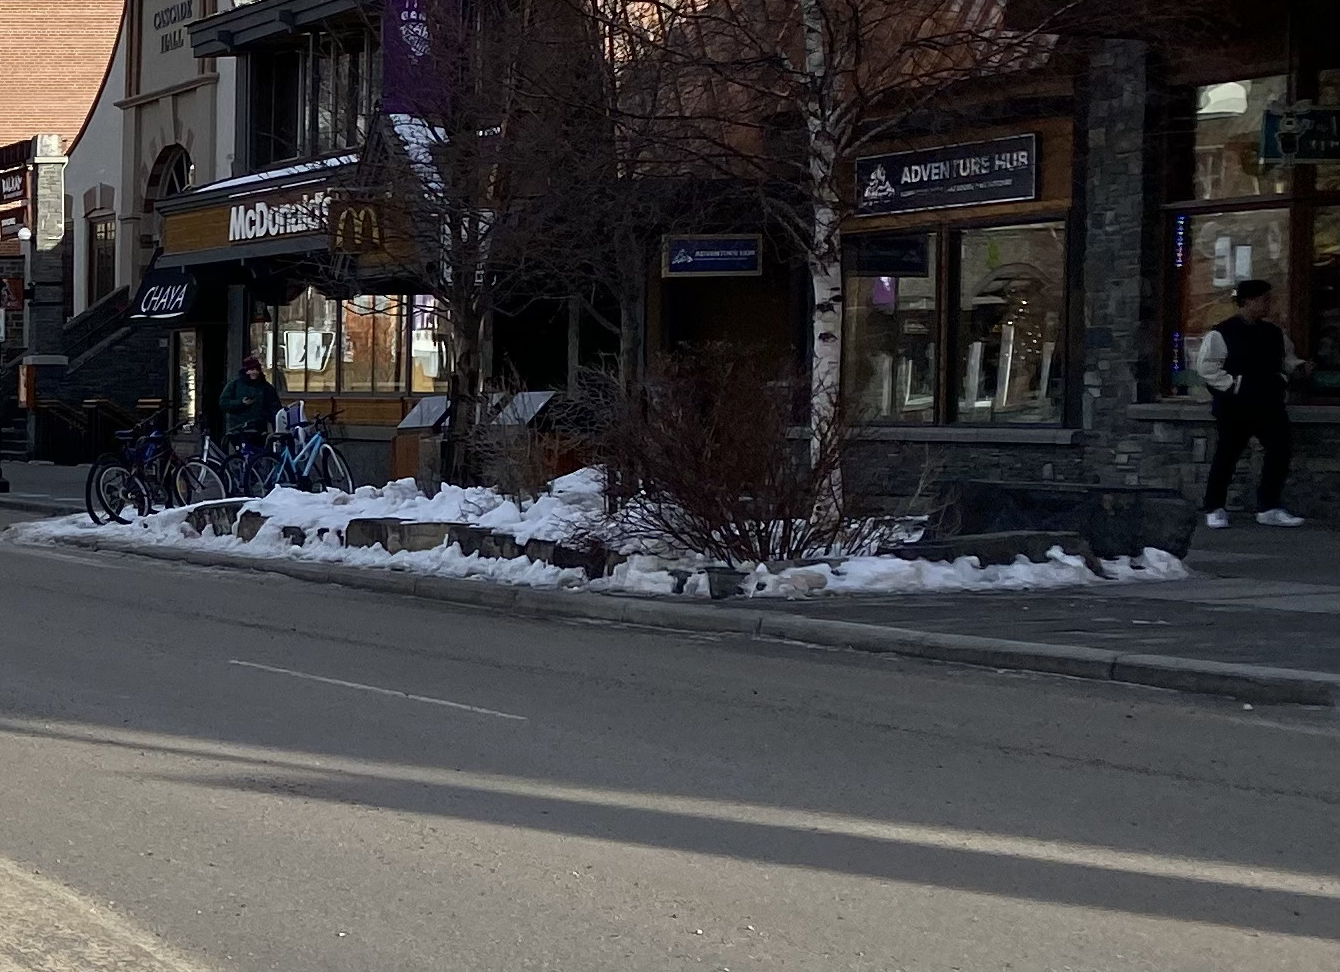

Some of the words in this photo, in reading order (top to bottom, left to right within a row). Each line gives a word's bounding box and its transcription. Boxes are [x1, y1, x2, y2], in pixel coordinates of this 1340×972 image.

[160, 28, 184, 54] HALL
[900, 156, 990, 184] ADVENTURE
[994, 151, 1029, 172] HUB
[141, 283, 189, 312] CHAYA
